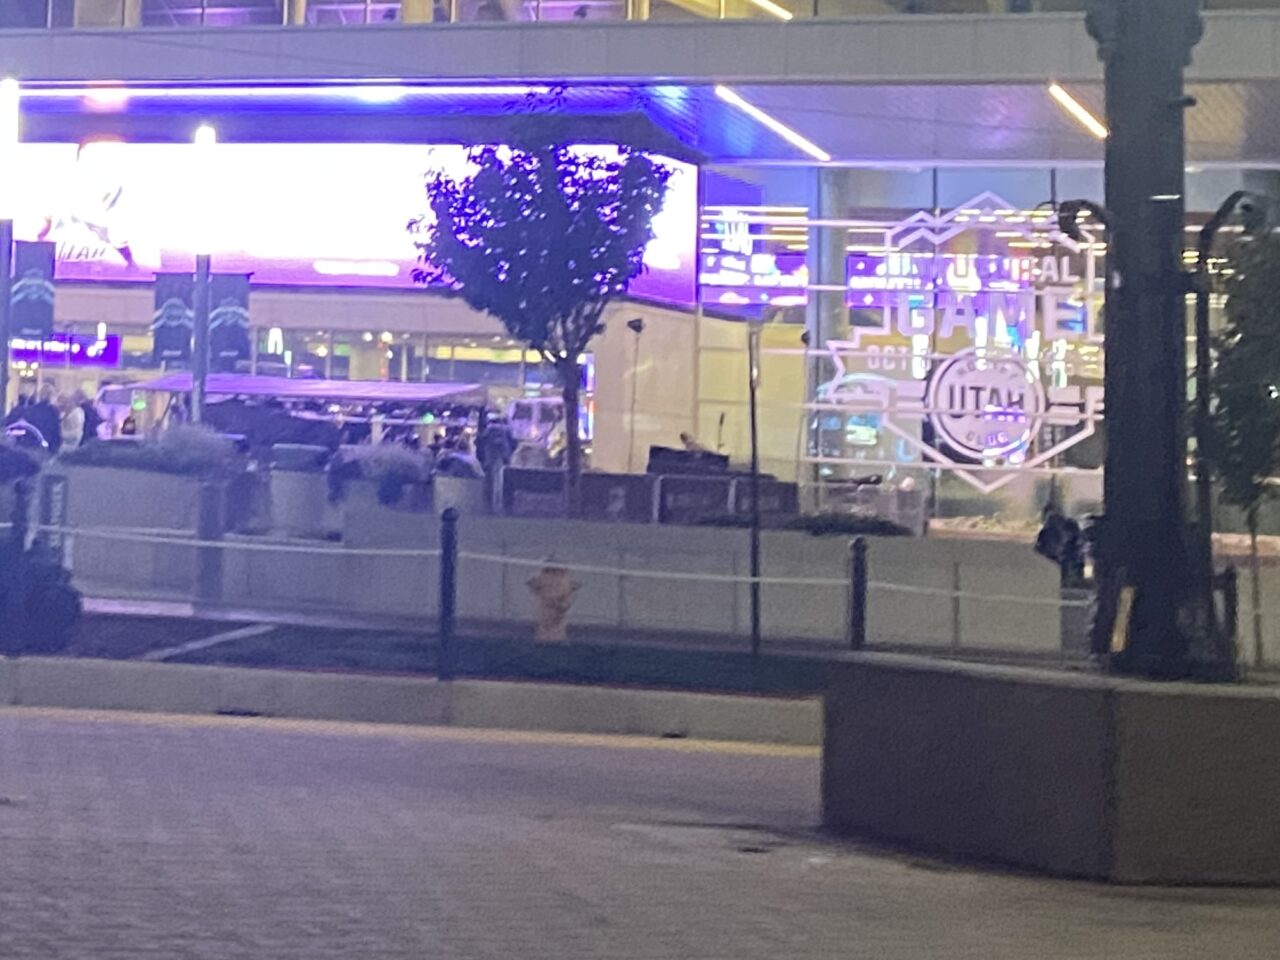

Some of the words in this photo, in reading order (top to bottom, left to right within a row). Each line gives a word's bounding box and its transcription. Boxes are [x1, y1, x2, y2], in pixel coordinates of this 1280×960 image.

[896, 287, 1085, 341] GAME
[866, 345, 908, 371] OCT
[948, 384, 1024, 418] UTAH
